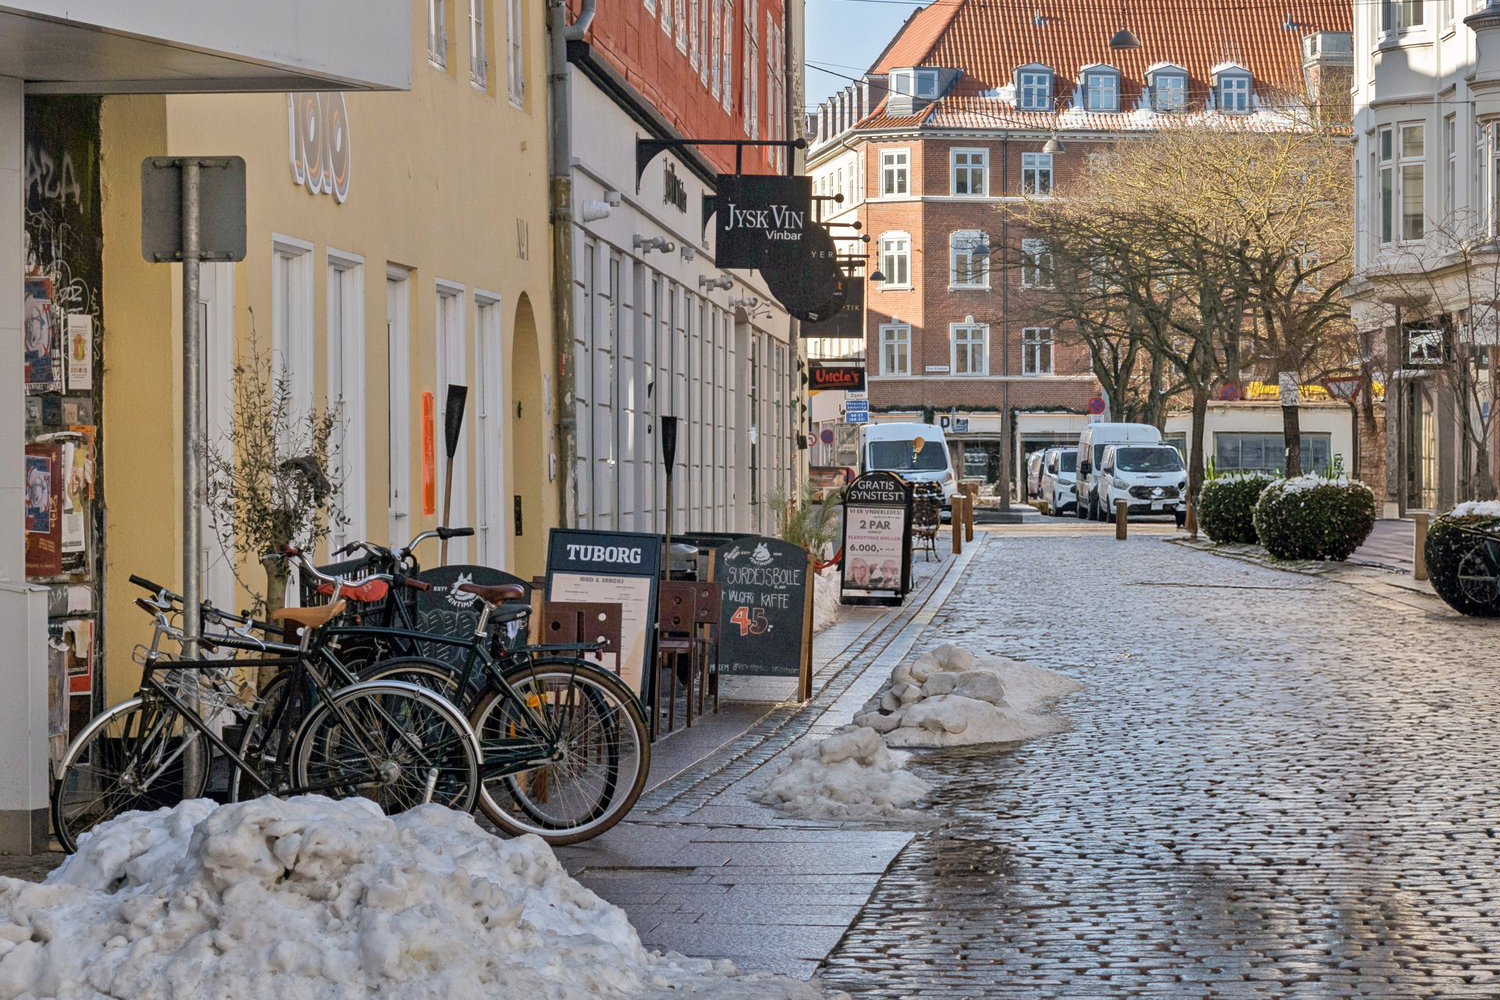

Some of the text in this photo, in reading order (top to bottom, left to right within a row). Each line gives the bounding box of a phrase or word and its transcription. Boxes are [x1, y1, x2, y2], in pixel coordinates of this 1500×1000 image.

[725, 203, 804, 231] JYSK VIN
[766, 230, 802, 240] Vinbar
[811, 250, 834, 258] YER
[858, 481, 894, 490] GRATIS
[851, 490, 901, 501] SYNSTEST
[859, 520, 891, 530] 2 PAR
[567, 544, 641, 564] TUBORG
[445, 595, 476, 608] FENTIMA
